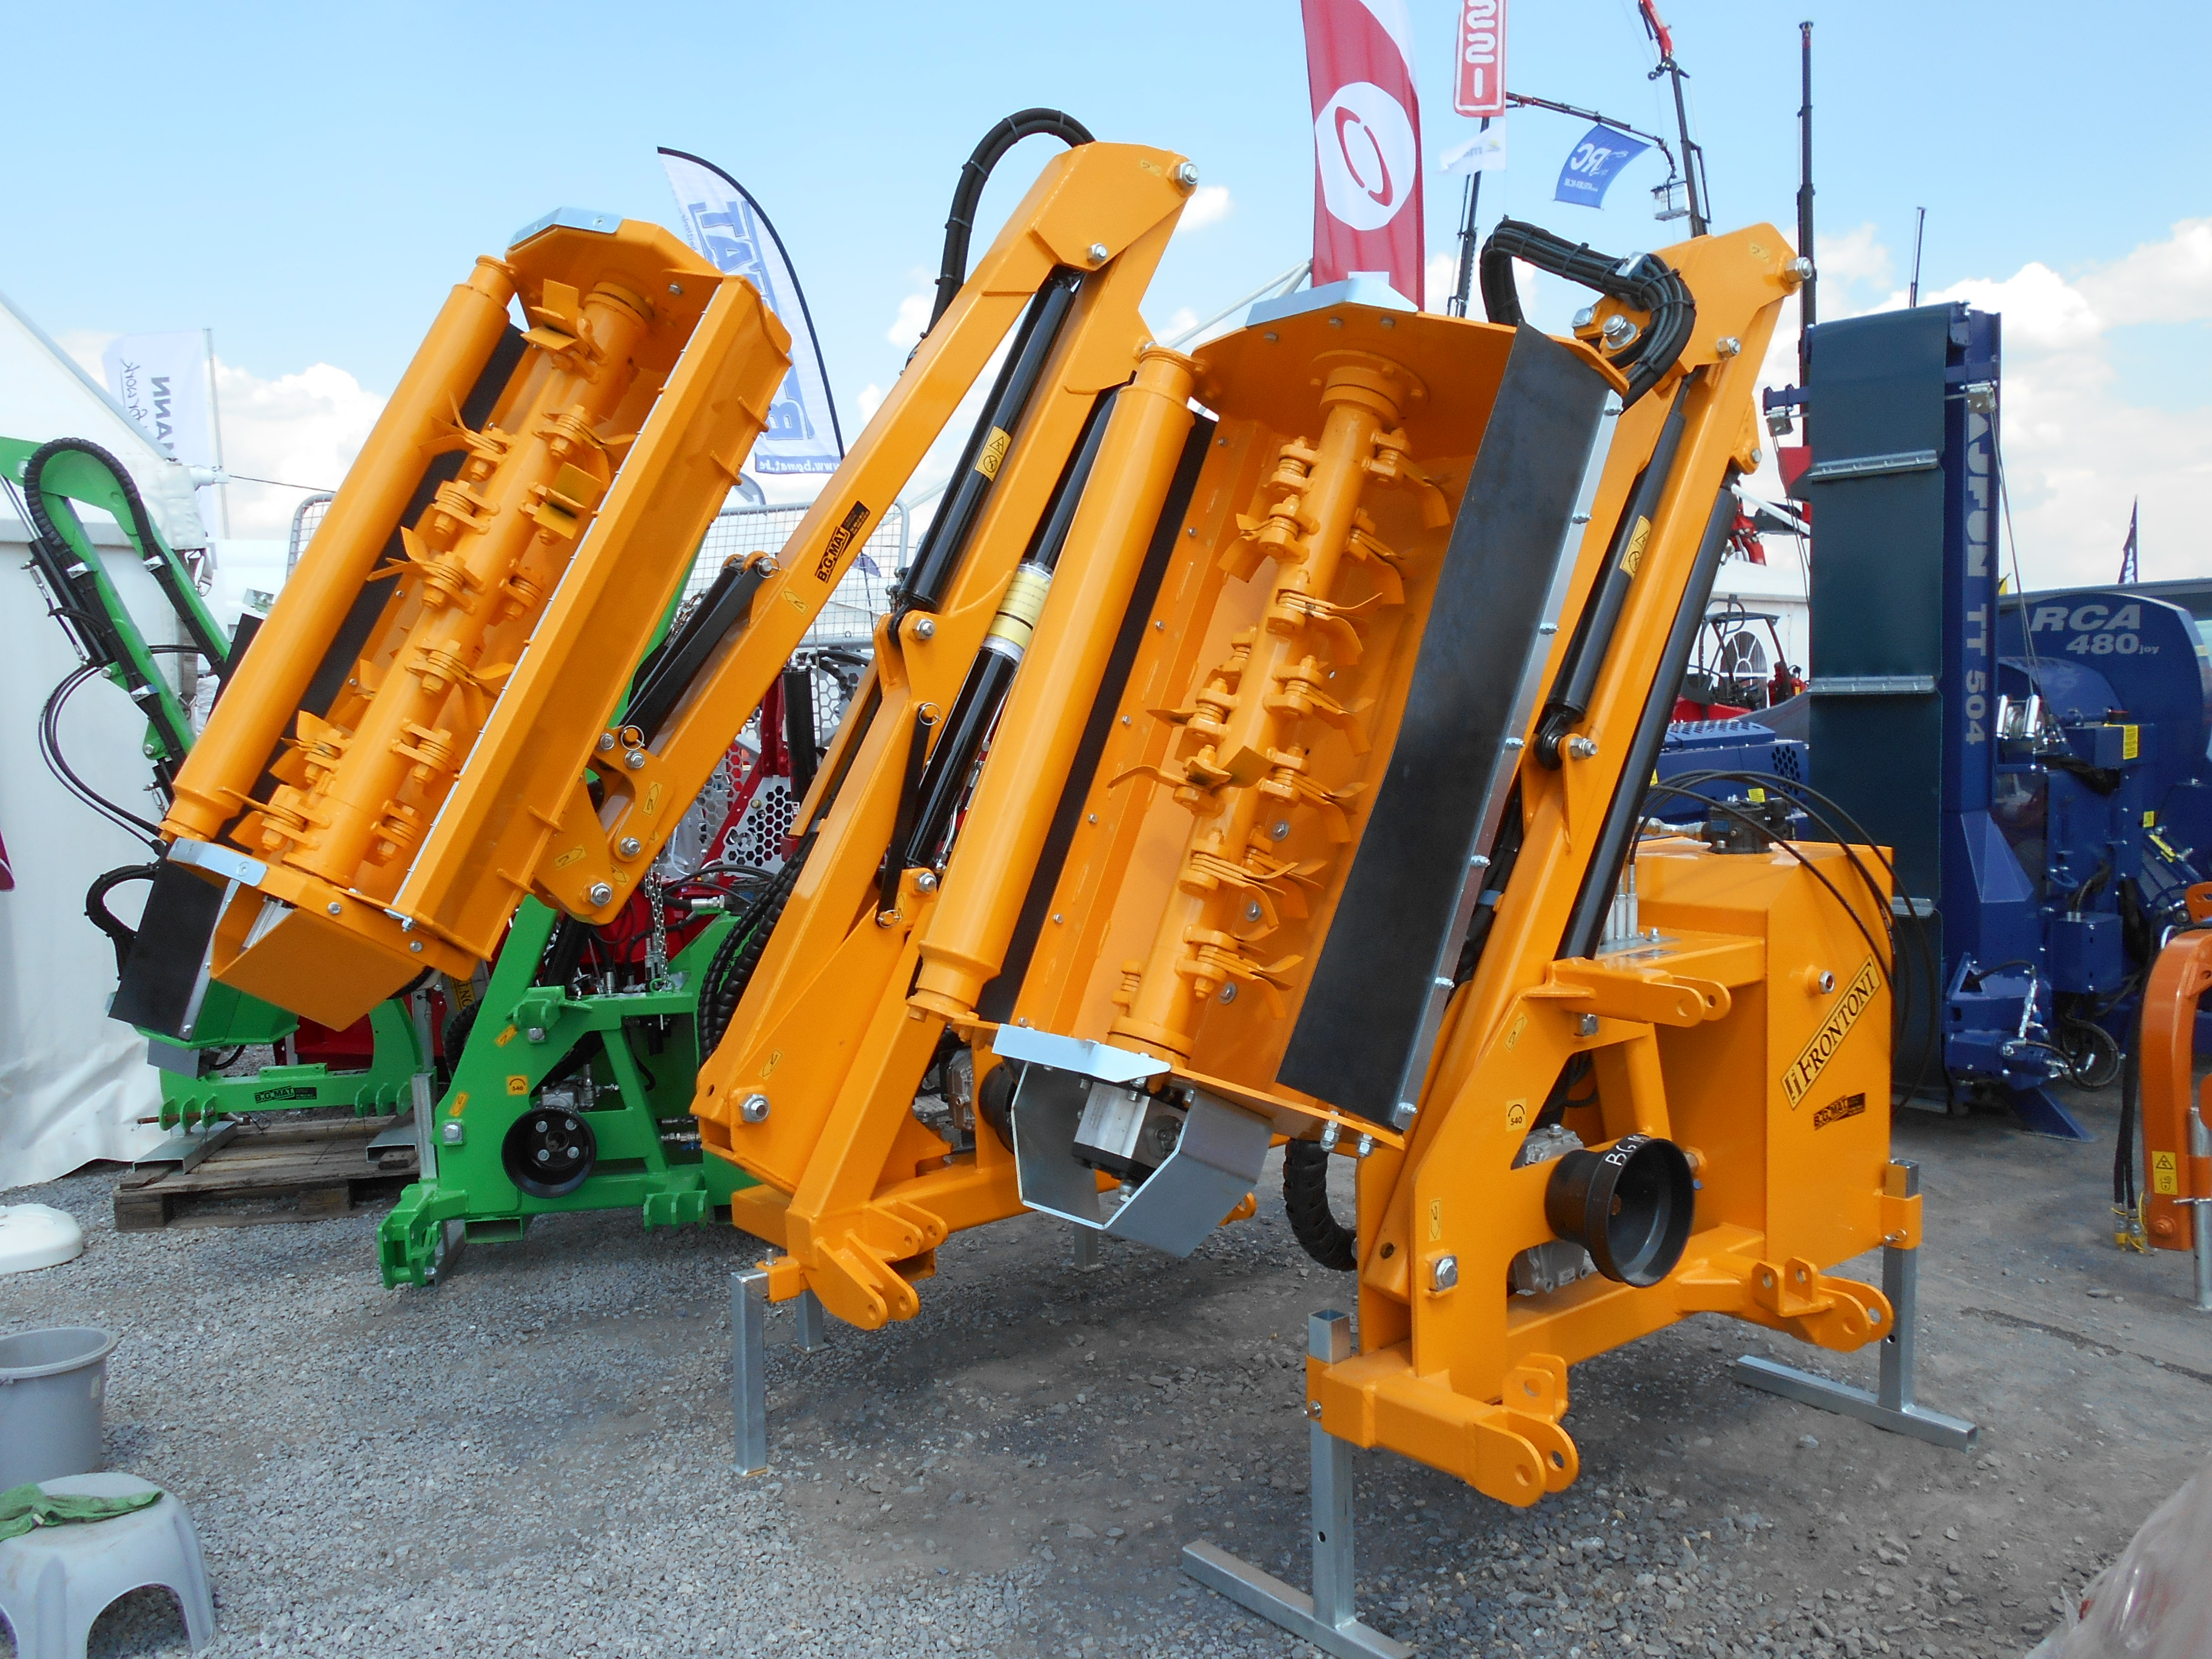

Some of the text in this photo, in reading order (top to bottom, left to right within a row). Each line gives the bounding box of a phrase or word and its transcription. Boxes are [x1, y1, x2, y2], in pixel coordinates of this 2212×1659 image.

[816, 528, 848, 581] B.G.MAT
[1966, 603, 1987, 656] TT
[2030, 604, 2141, 632] RCA
[2066, 633, 2139, 655] 480
[1965, 669, 1986, 745] 504
[1797, 962, 1876, 1087] FRONTONI
[255, 1088, 293, 1102] B.G.MAT
[1510, 1116, 1523, 1126] 540
